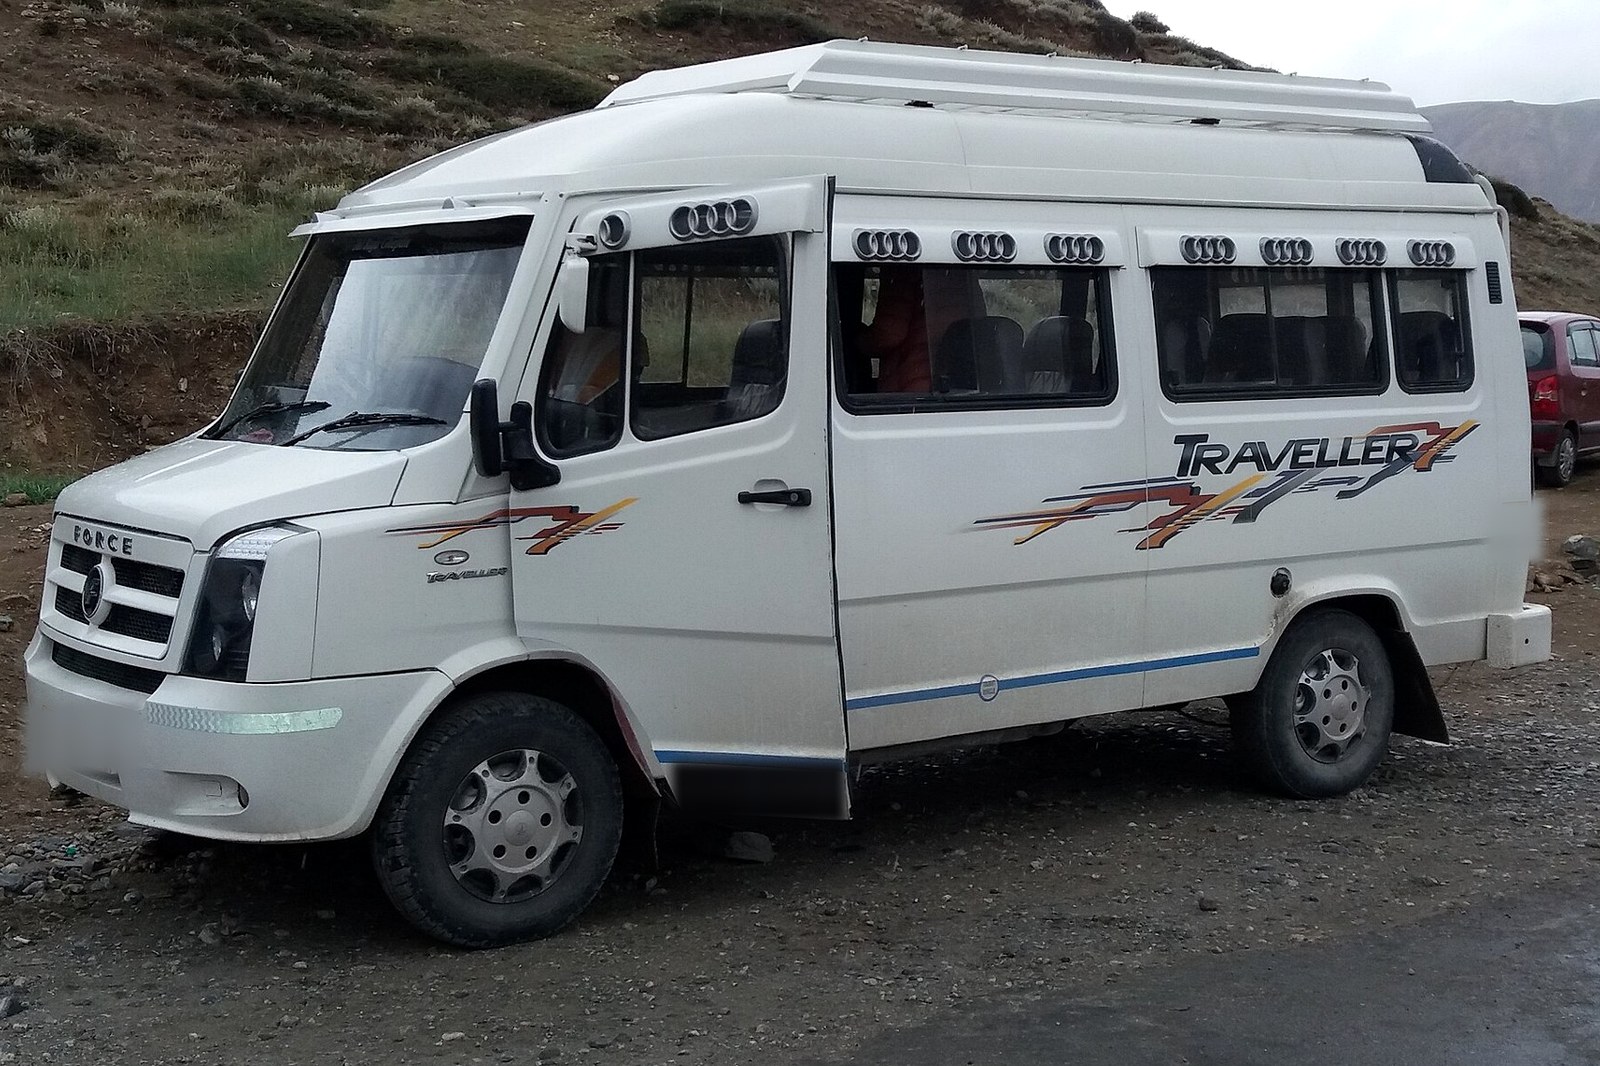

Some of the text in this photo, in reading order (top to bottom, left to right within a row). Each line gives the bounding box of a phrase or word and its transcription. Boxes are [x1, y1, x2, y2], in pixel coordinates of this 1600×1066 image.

[1173, 433, 1420, 477] TRAVELLER
[73, 525, 133, 556] FORCE
[426, 567, 508, 584] TRAVELLER
